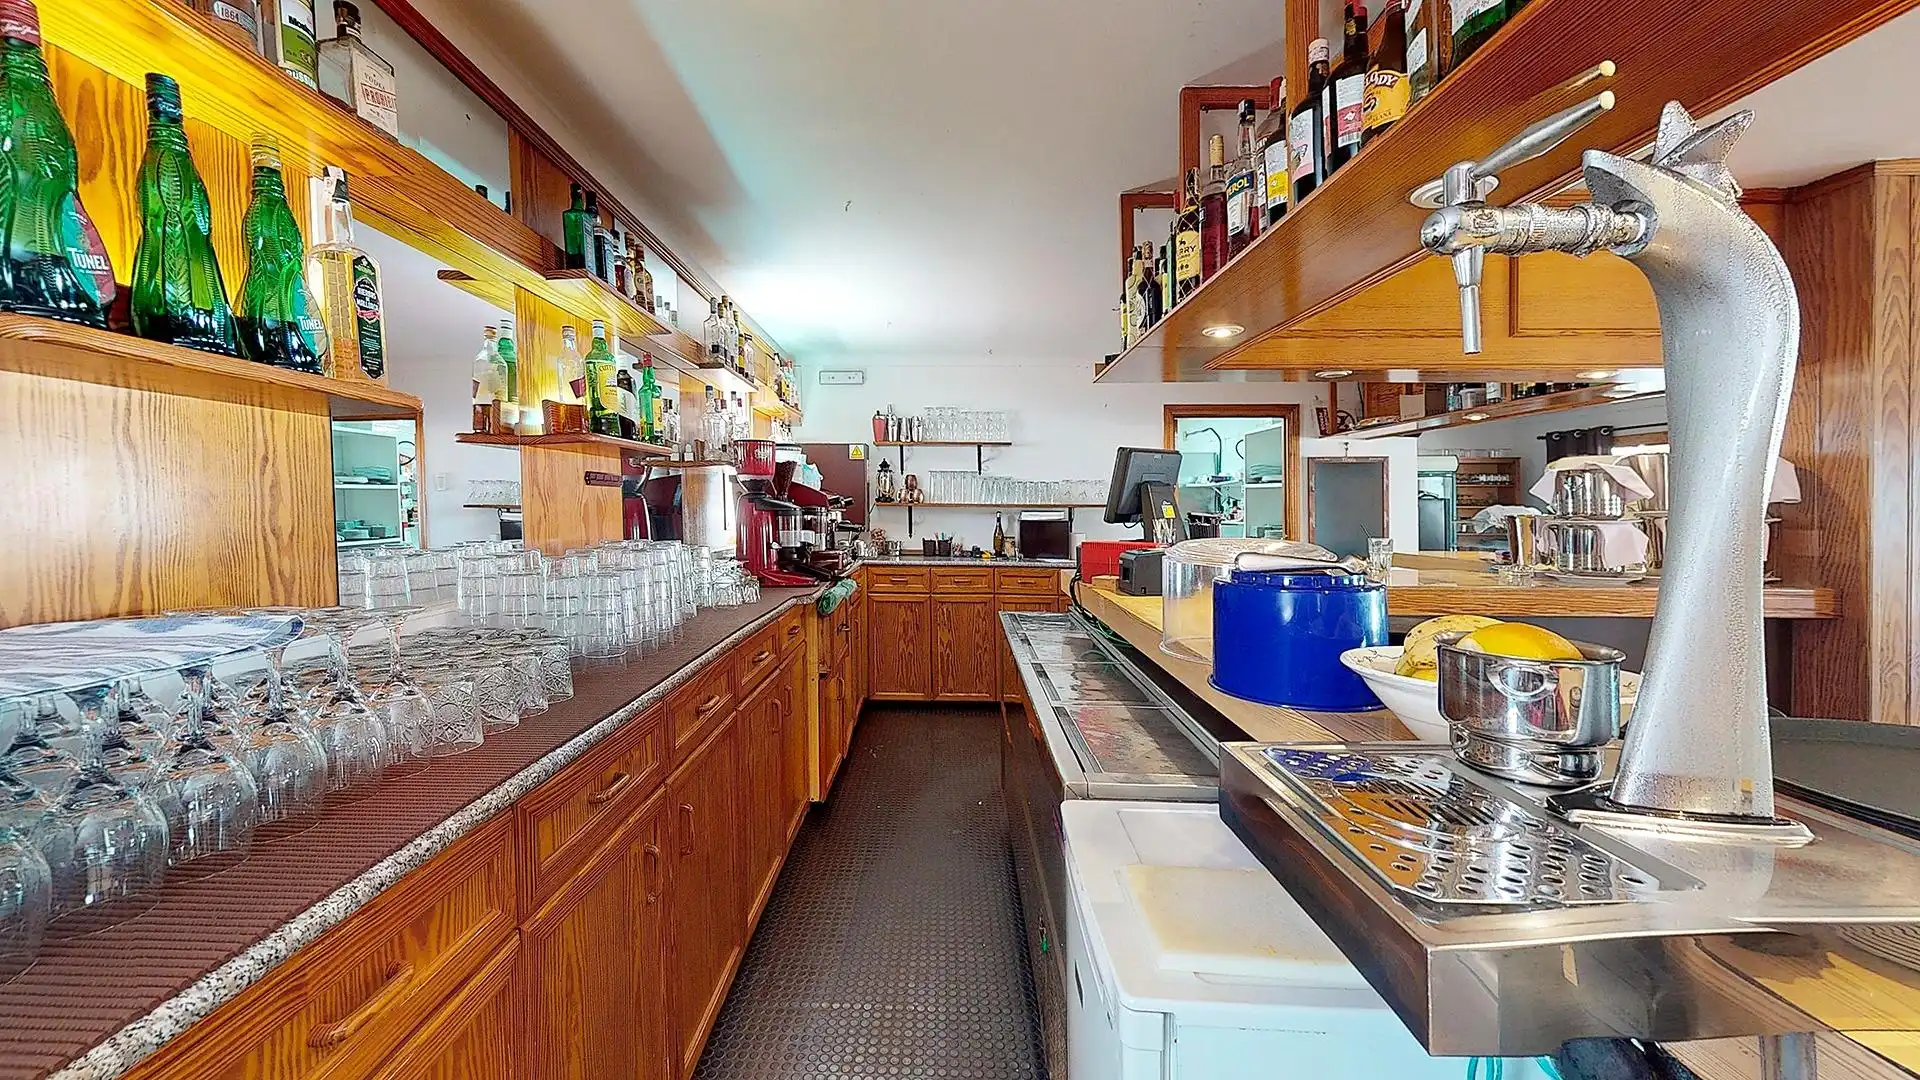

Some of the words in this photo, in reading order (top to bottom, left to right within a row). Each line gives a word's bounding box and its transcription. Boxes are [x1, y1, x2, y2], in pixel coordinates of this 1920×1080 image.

[1365, 71, 1398, 86] LODY
[1226, 177, 1250, 196] EROL
[66, 246, 110, 270] TÚNEL
